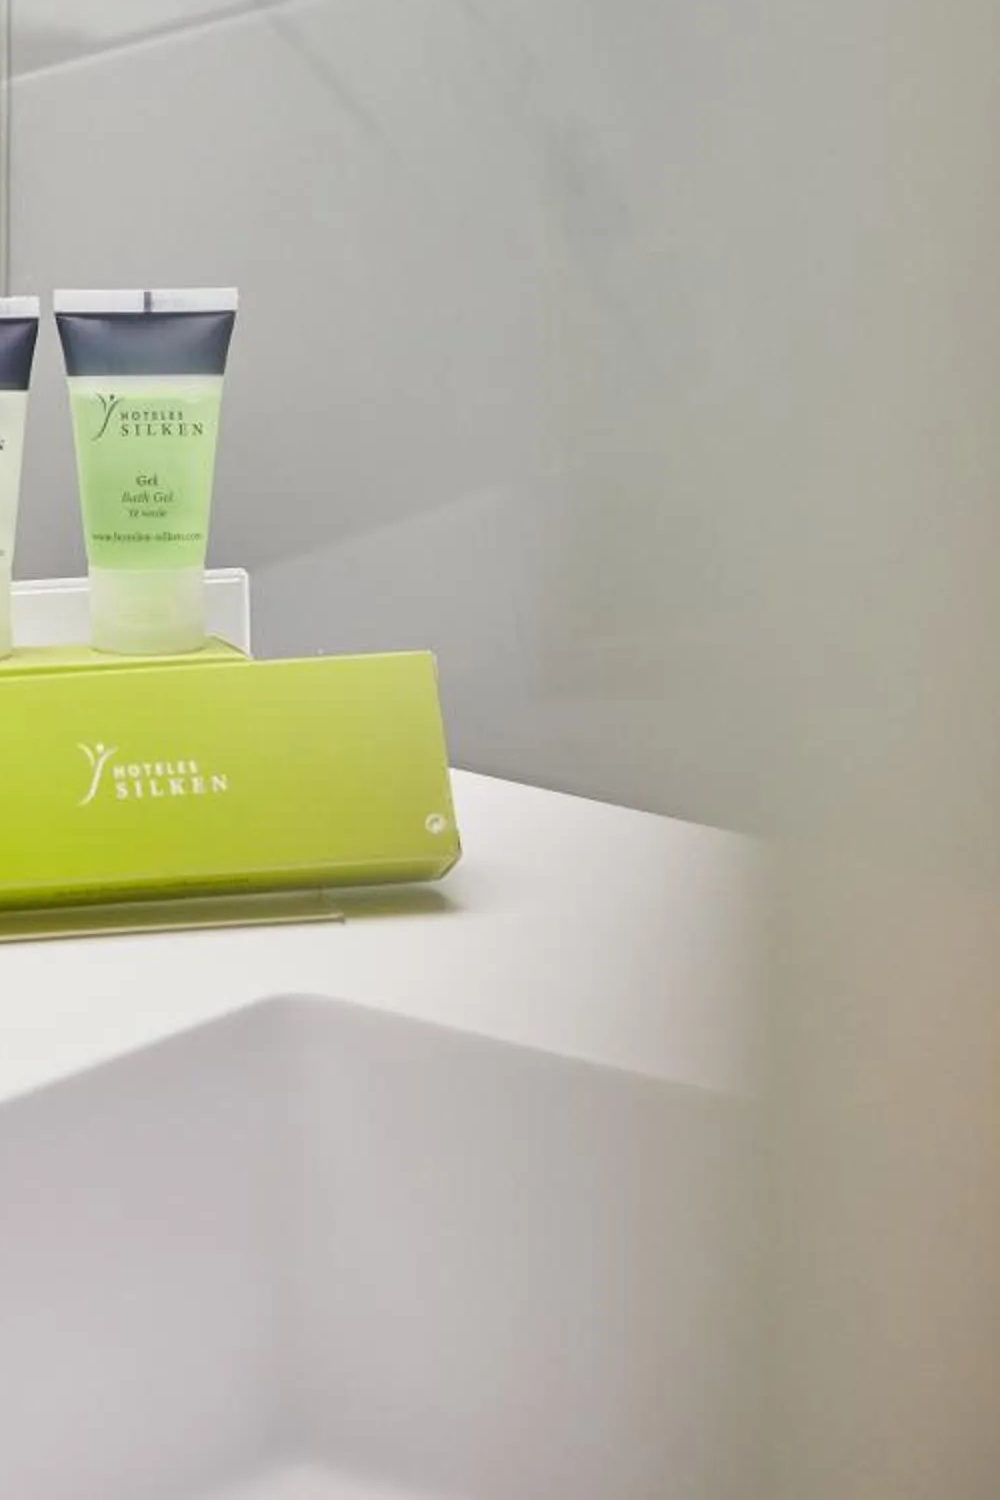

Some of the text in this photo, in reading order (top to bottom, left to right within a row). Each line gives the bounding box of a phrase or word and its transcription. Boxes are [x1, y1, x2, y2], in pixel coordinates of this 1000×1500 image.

[119, 410, 184, 421] HOTELES
[121, 422, 204, 437] SILKEN
[135, 473, 159, 487] Gel
[153, 490, 174, 503] Gel
[112, 759, 199, 780] HOTELES
[115, 773, 229, 800] SILKEN
